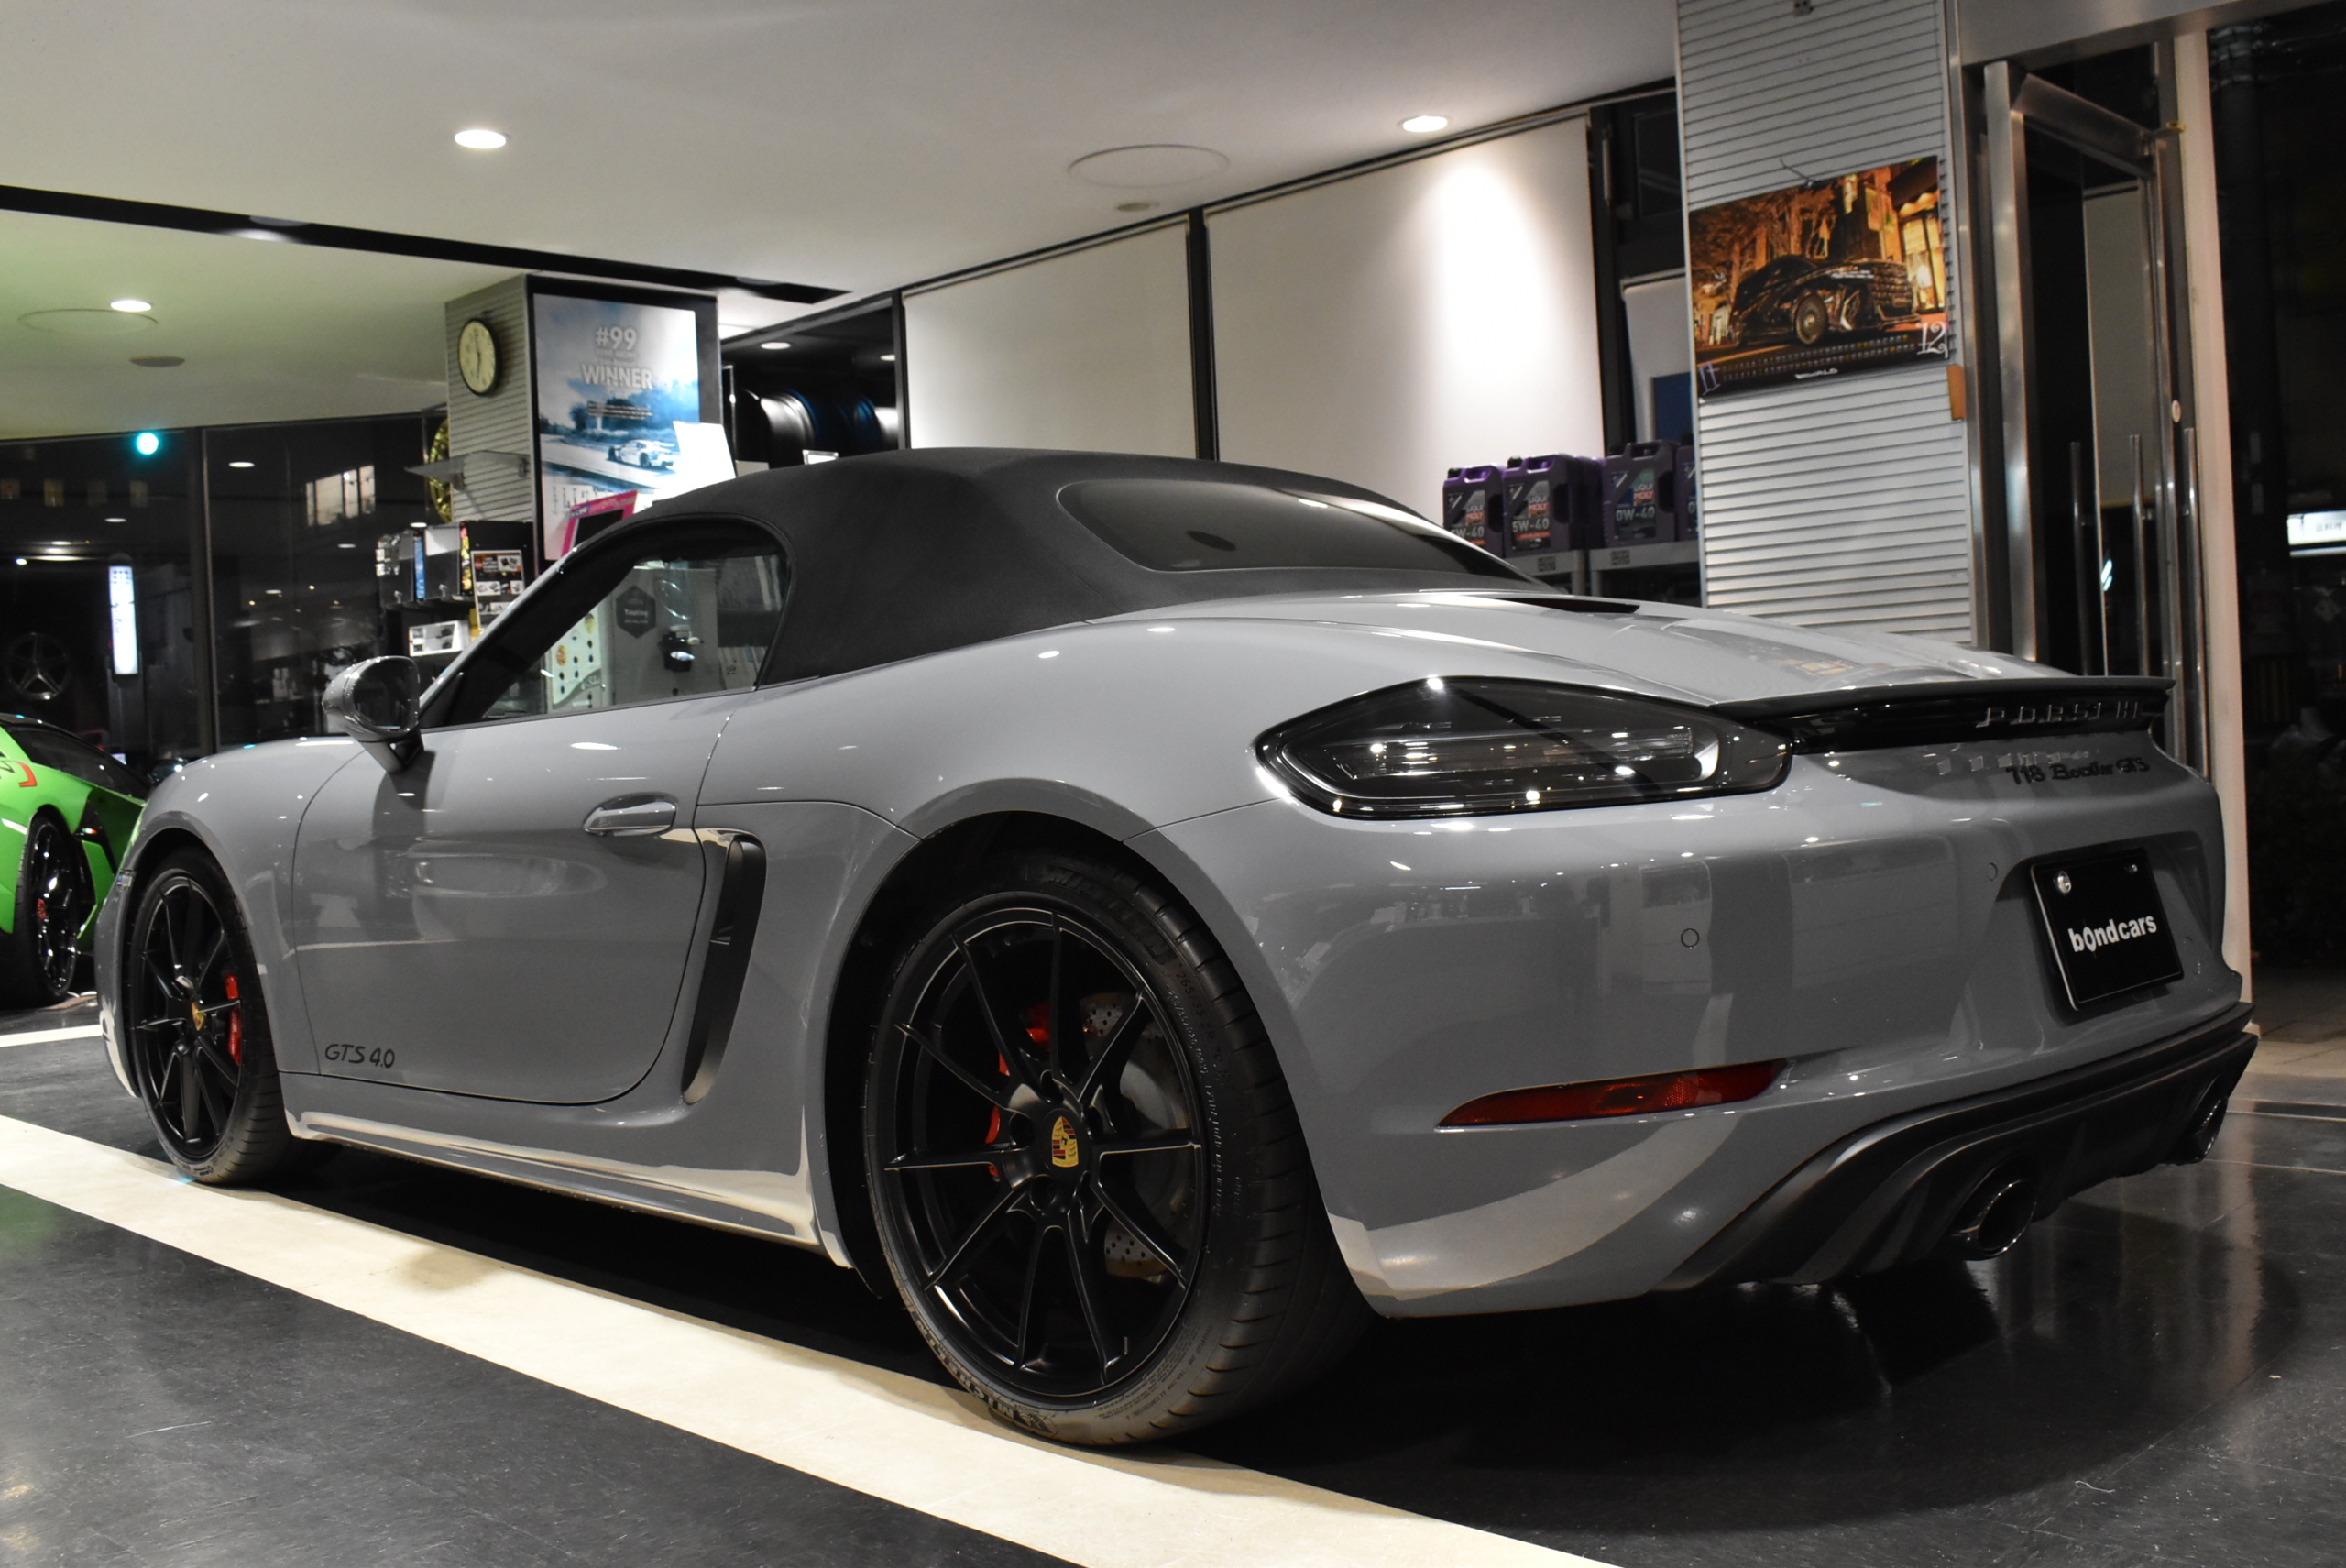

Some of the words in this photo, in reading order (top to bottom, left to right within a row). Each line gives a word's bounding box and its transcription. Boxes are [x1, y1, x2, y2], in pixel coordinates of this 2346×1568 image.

[595, 325, 637, 351] #99
[581, 363, 654, 390] WINNER
[1512, 518, 1550, 533] 5W-40
[1616, 505, 1656, 521] 0W-40
[2005, 764, 2046, 785] 718
[2067, 916, 2157, 952] bondcars
[325, 1044, 365, 1064] GTS
[369, 1047, 395, 1069] 4.0
